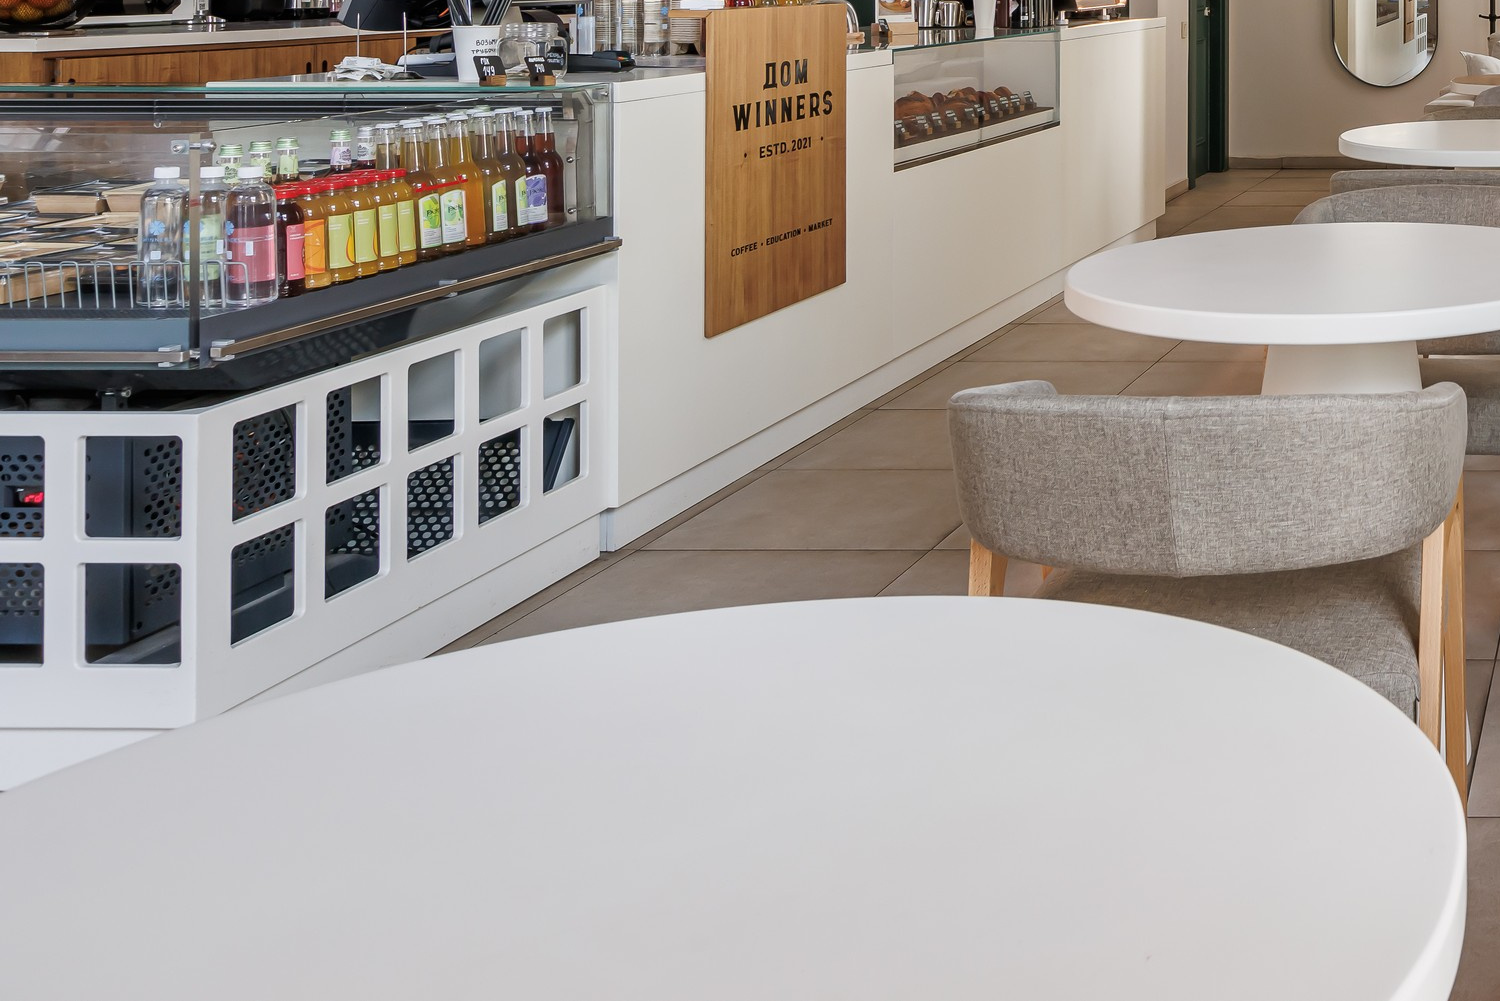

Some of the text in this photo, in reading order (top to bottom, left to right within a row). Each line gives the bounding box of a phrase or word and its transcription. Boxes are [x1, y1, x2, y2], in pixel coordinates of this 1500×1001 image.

[763, 59, 808, 91] ДОМ
[732, 90, 833, 132] WINNERS
[731, 218, 833, 257] COFFEE EDUCATION MARKET
